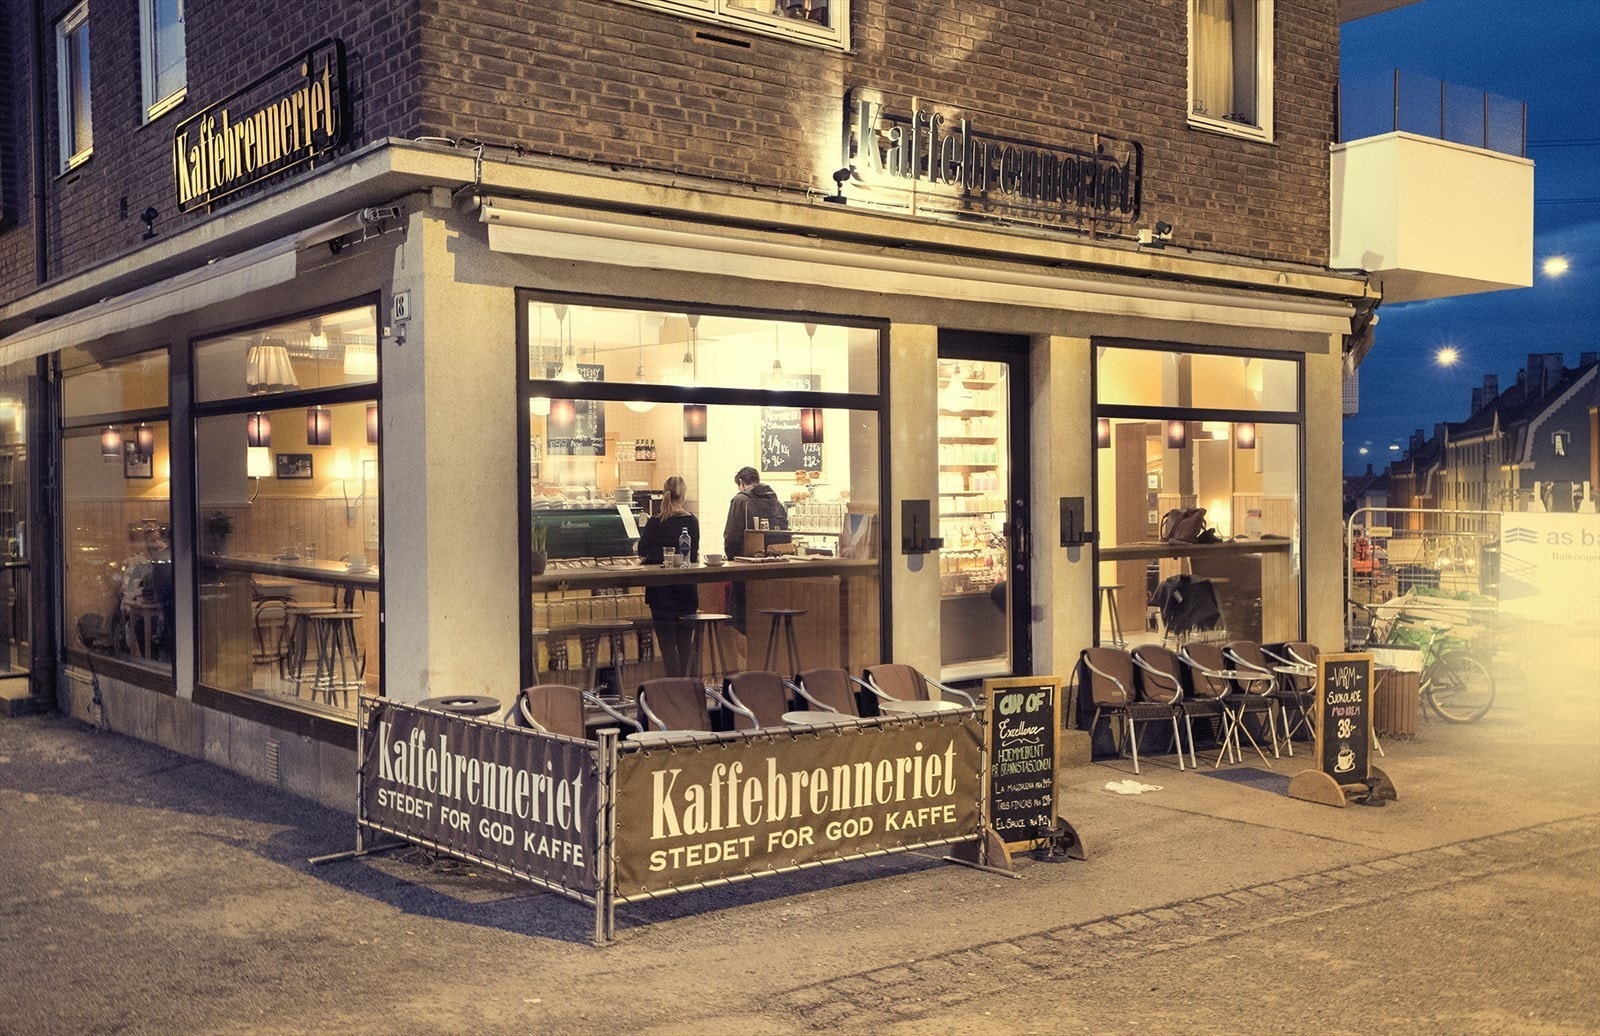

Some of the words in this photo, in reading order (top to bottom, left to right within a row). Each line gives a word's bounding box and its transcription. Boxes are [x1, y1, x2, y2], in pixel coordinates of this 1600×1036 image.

[177, 51, 336, 204] Kaffebrenneriet
[857, 100, 1133, 214] Kaffebrenneriet
[396, 296, 404, 317] 18
[1547, 530, 1574, 546] as
[1000, 695, 1024, 716] CUP
[1026, 692, 1046, 713] OF
[378, 720, 583, 834] Kaffebrenneriet
[650, 738, 957, 840] Kaffebrenneriet
[377, 788, 432, 822] STEDET
[440, 807, 472, 832] FOR
[478, 818, 515, 846] GOD
[524, 832, 585, 868] KAFFE
[649, 836, 756, 872] STEDET
[767, 828, 814, 851] FOR
[826, 816, 874, 842] GOD
[885, 804, 958, 832] KAFFE
